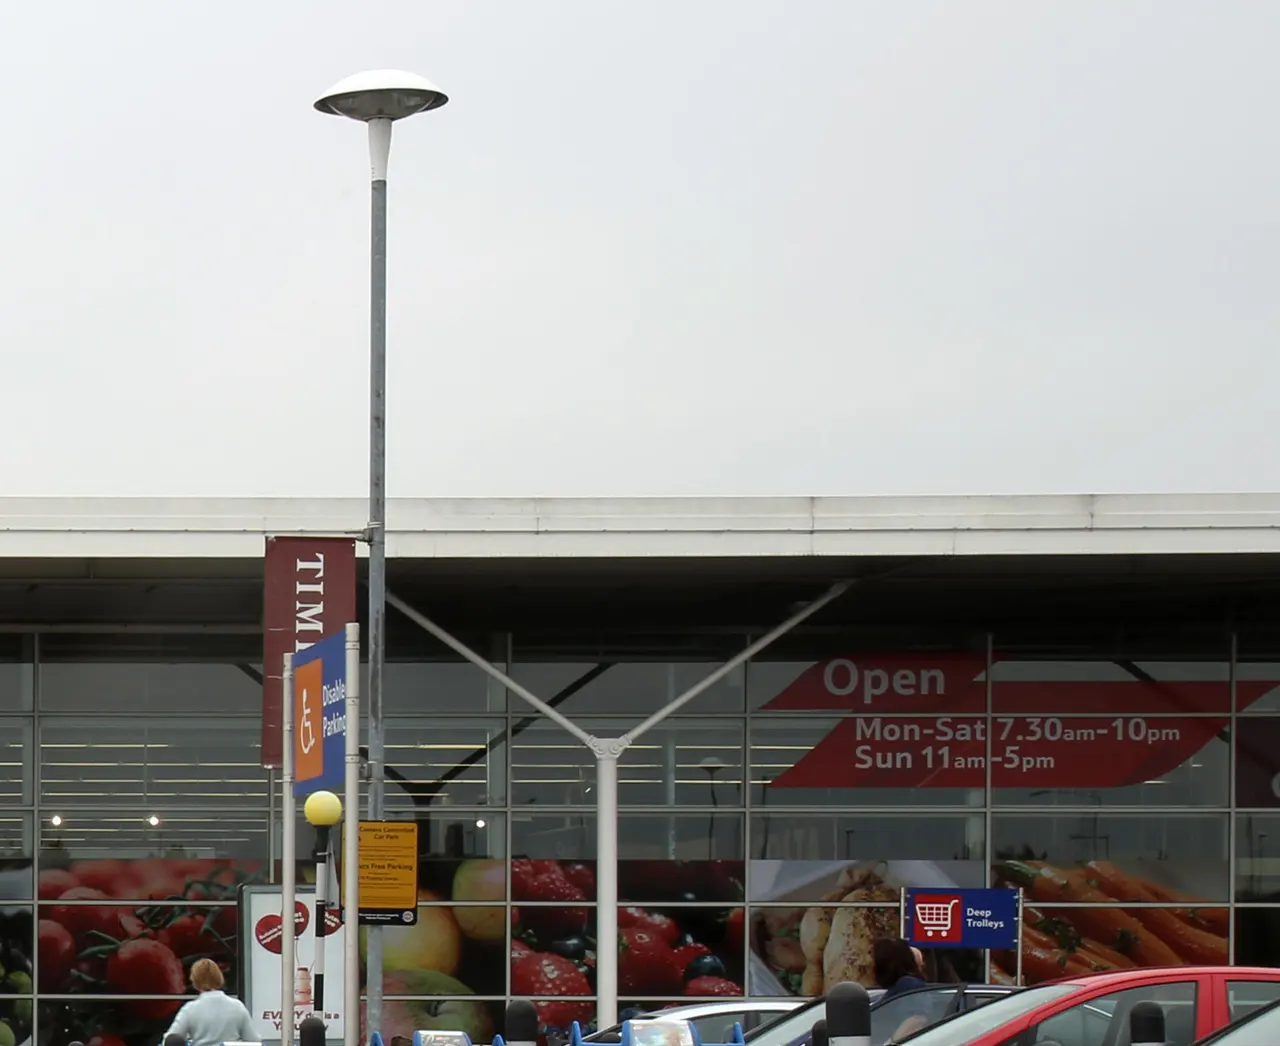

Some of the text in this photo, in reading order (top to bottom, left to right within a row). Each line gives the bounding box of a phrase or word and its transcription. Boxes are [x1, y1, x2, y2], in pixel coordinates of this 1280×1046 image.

[322, 678, 346, 707] Disable
[823, 658, 945, 704] Open
[855, 718, 1180, 744] Mon-Sat 7.30am-10pm
[854, 746, 1055, 772] Sun 11am-5pm
[966, 908, 991, 917] Deep
[966, 919, 1004, 929] Trolleys
[262, 1010, 304, 1020] EVY
